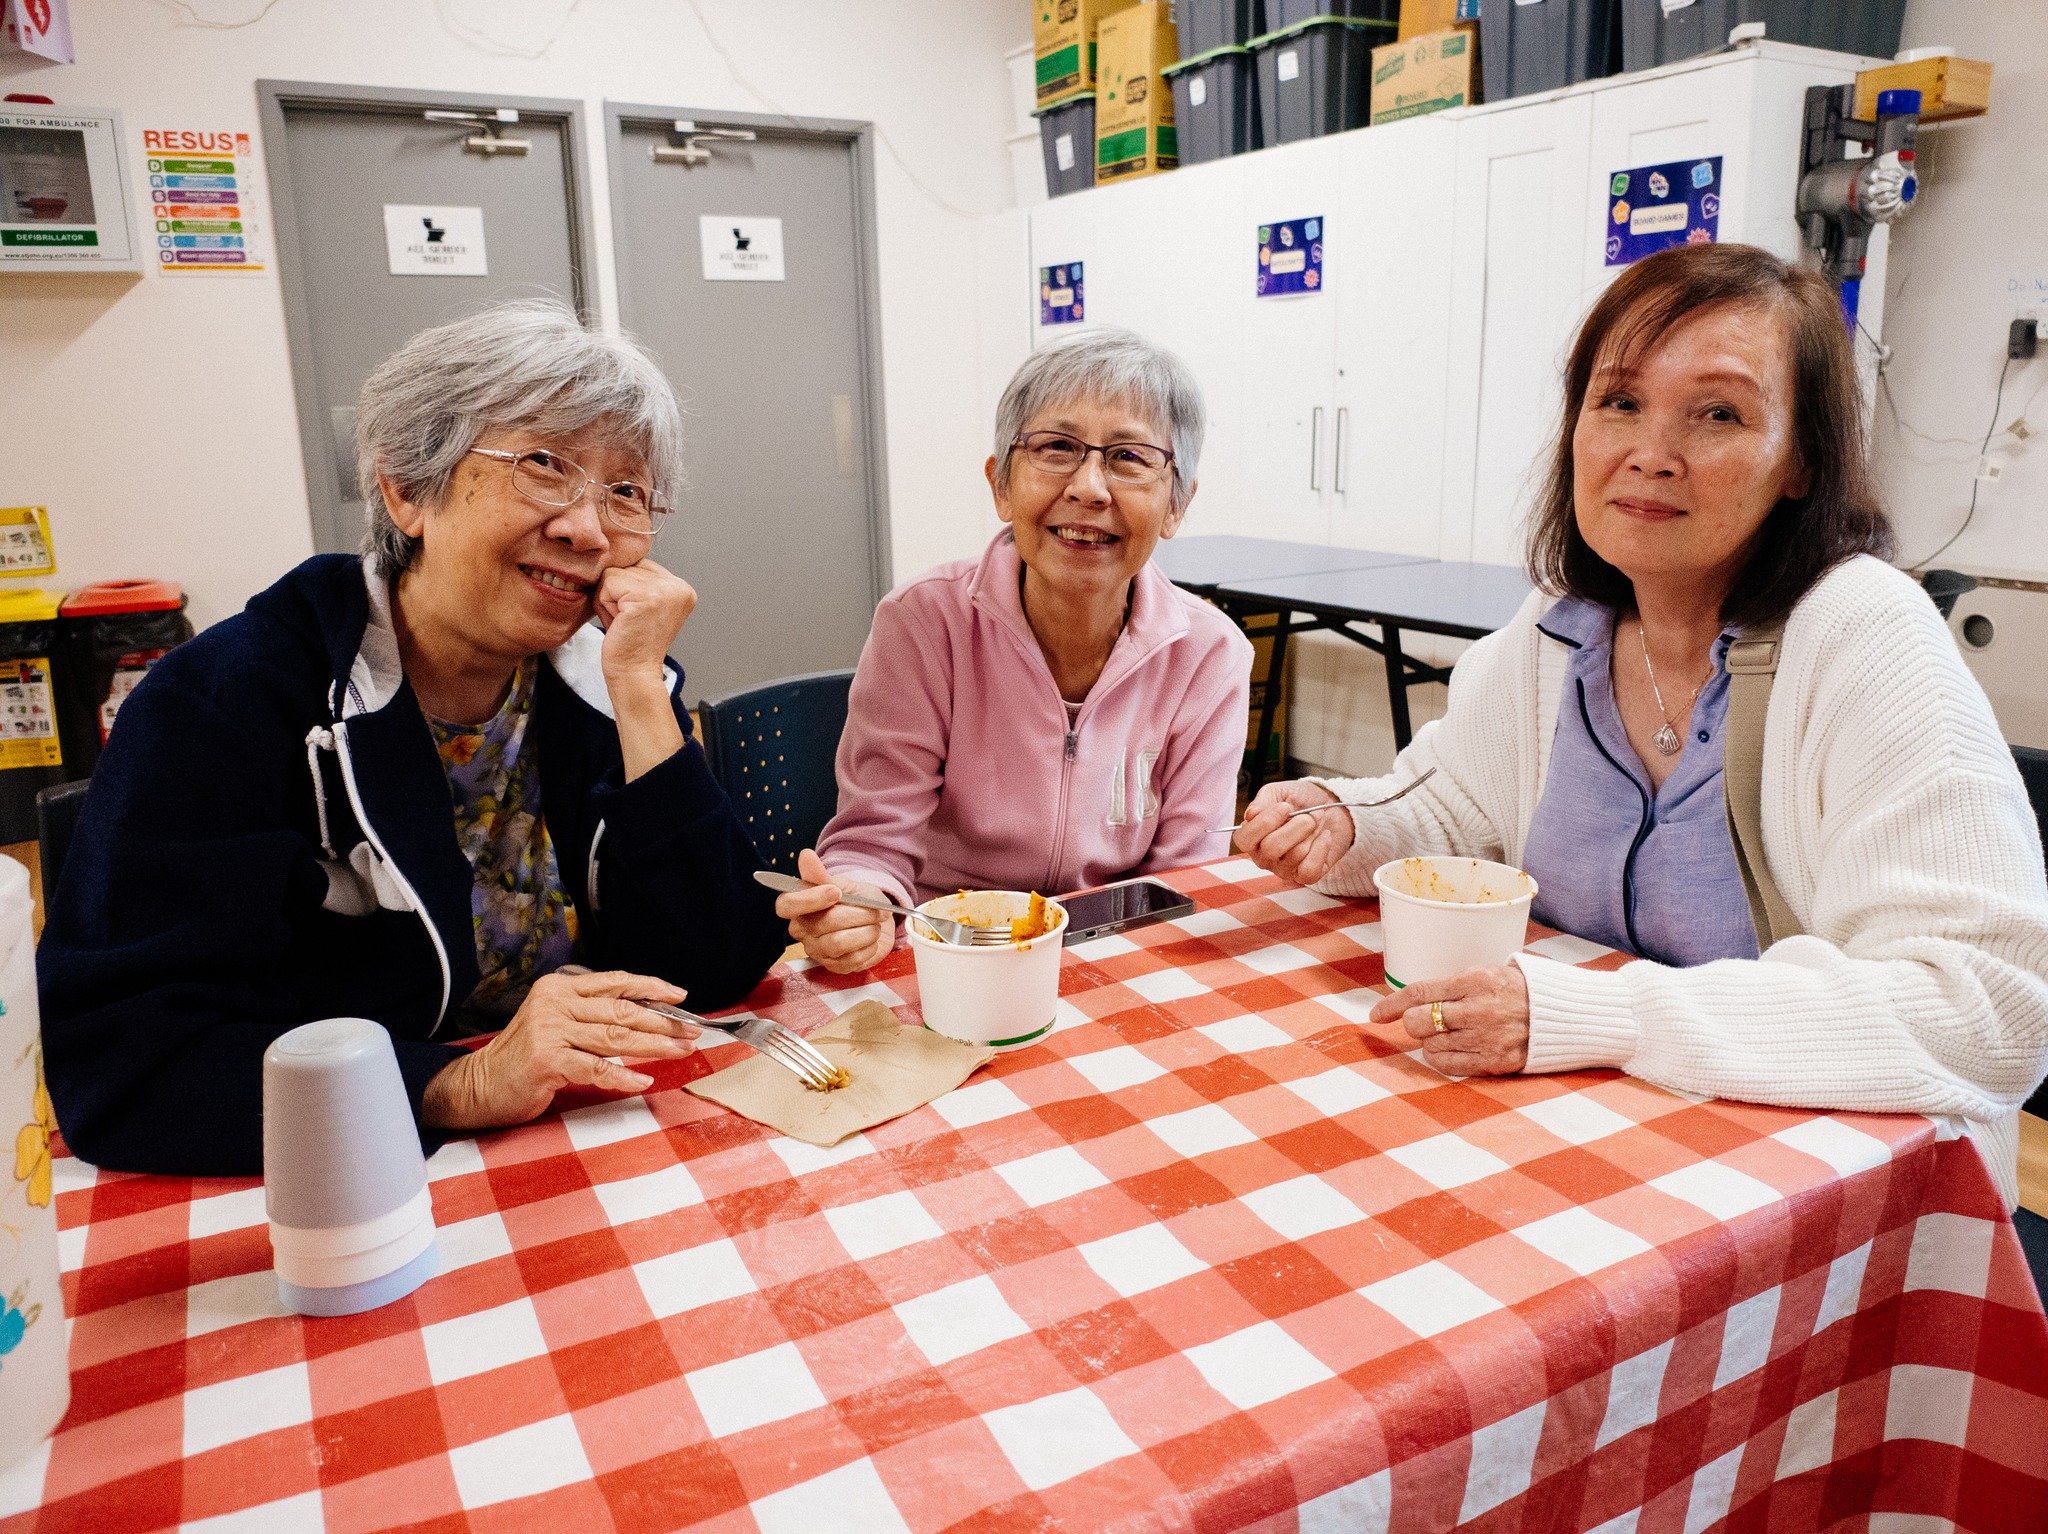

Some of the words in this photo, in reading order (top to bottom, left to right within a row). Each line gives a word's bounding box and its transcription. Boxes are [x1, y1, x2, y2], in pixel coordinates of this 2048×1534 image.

[17, 118, 37, 126] FOR
[40, 119, 100, 128] AMBULANCE
[144, 130, 234, 151] RESUS
